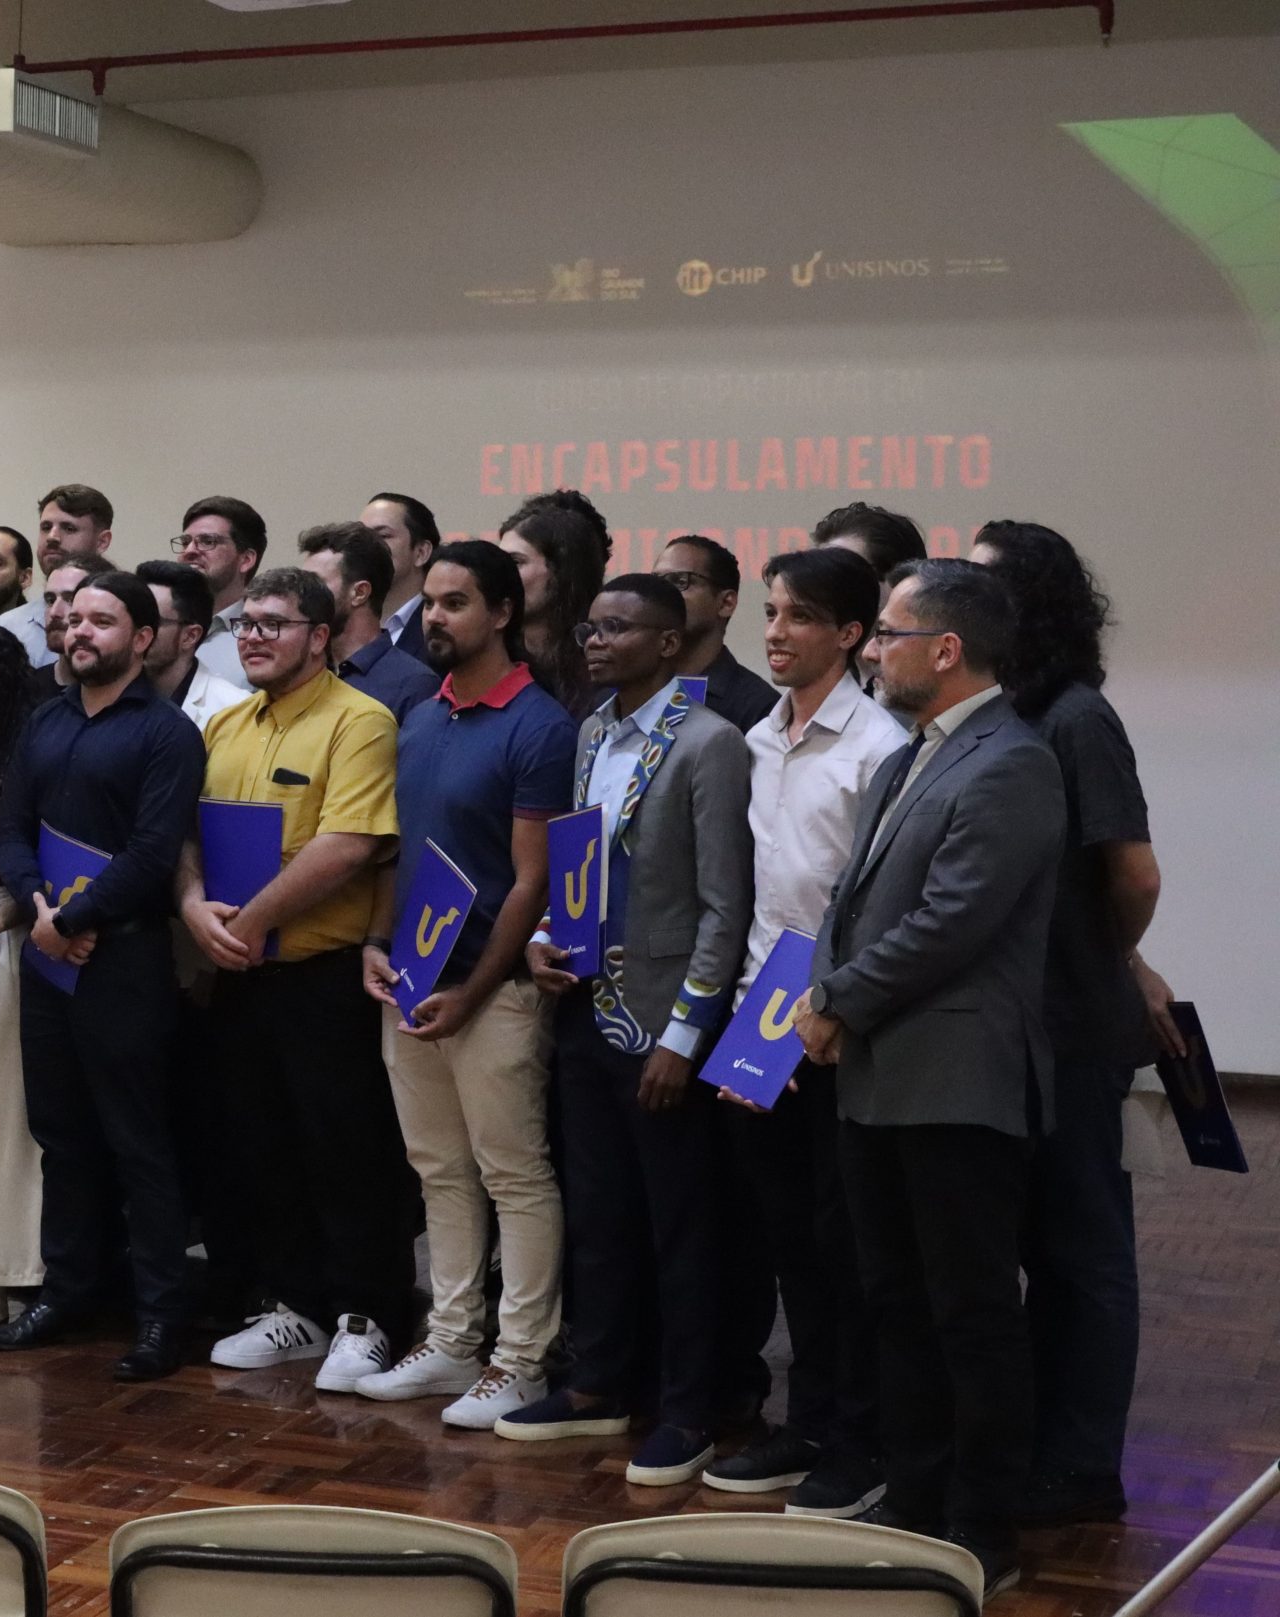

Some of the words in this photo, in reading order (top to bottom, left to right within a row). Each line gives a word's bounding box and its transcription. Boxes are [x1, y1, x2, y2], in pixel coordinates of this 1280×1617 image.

[715, 267, 768, 285] CHIP
[825, 259, 931, 280] UNISINOS
[479, 434, 993, 496] ENCAPSULAMENTO
